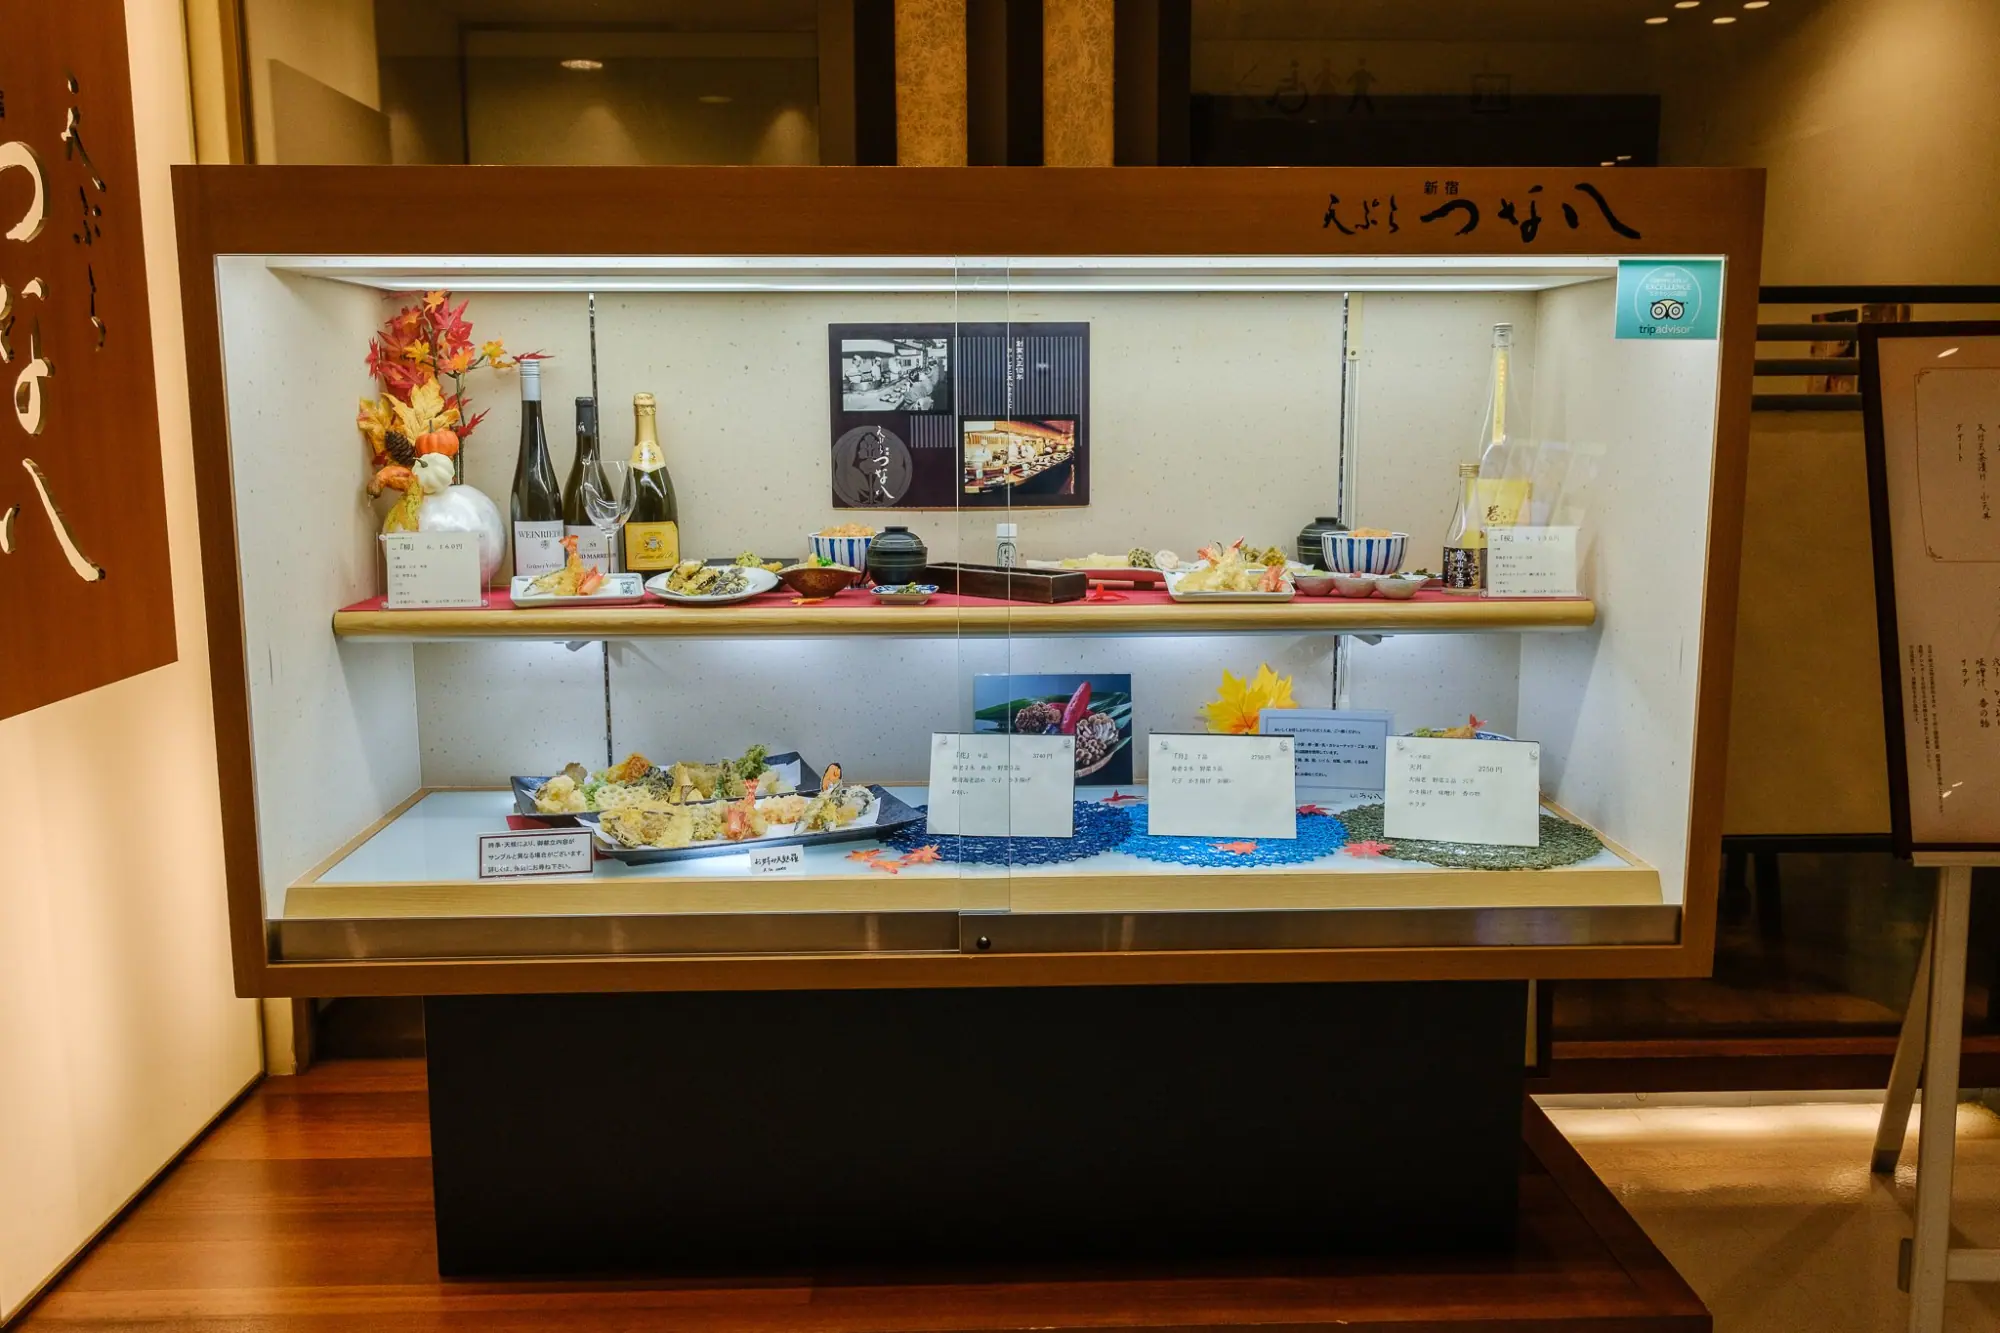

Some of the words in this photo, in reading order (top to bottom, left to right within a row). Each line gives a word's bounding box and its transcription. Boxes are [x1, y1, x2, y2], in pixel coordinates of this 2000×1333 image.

[1423, 180, 1460, 196] 新宿
[1420, 183, 1641, 244] つな八
[1639, 324, 1691, 336] tripadvisor
